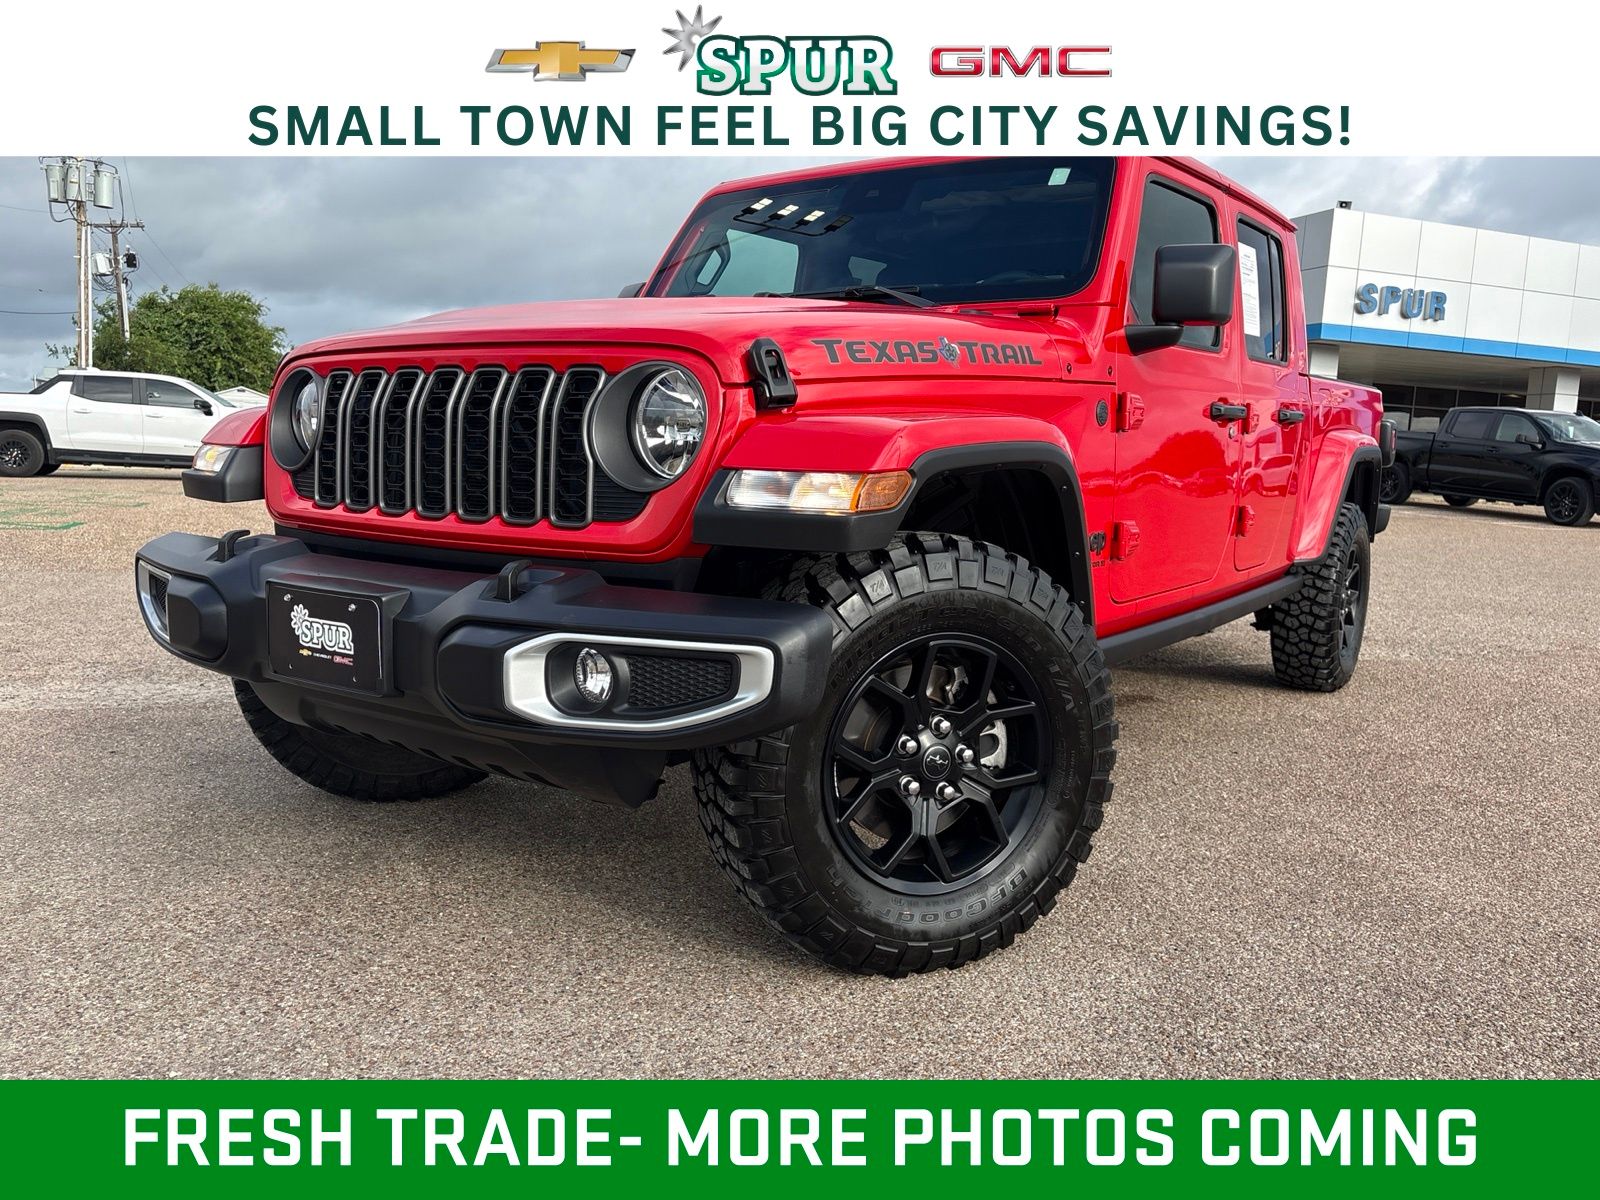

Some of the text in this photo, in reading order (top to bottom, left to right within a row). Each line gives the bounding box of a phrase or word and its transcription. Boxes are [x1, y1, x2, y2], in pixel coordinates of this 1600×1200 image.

[1354, 283, 1448, 322] SPUR
[811, 338, 1043, 365] TEXAS TRAIL
[300, 618, 354, 653] SPUR
